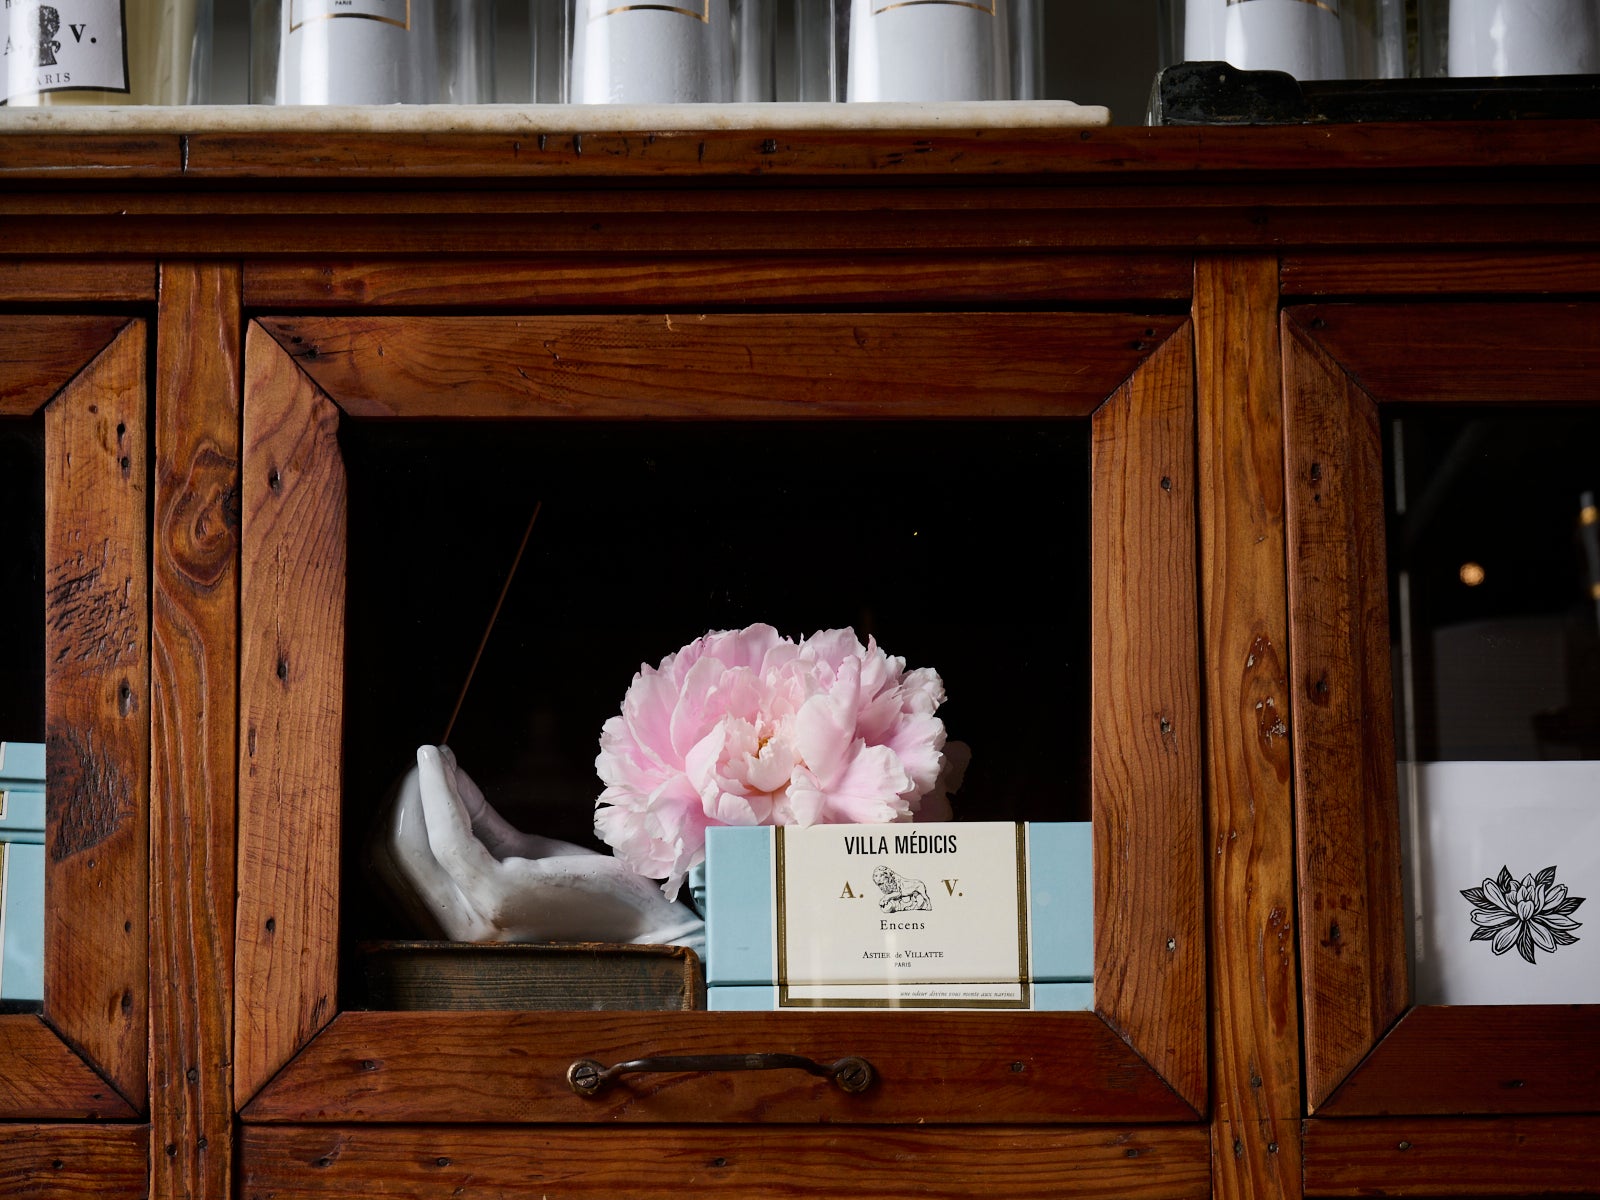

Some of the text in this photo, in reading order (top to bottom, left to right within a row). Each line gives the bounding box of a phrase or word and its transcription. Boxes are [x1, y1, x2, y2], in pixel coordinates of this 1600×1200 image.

[68, 23, 97, 44] V.
[844, 830, 957, 855] VILLA MÉDICIS
[839, 878, 963, 899] A. V.
[880, 919, 925, 930] Encens
[862, 951, 891, 959] ASTIER
[904, 950, 944, 959] VILLATTE
